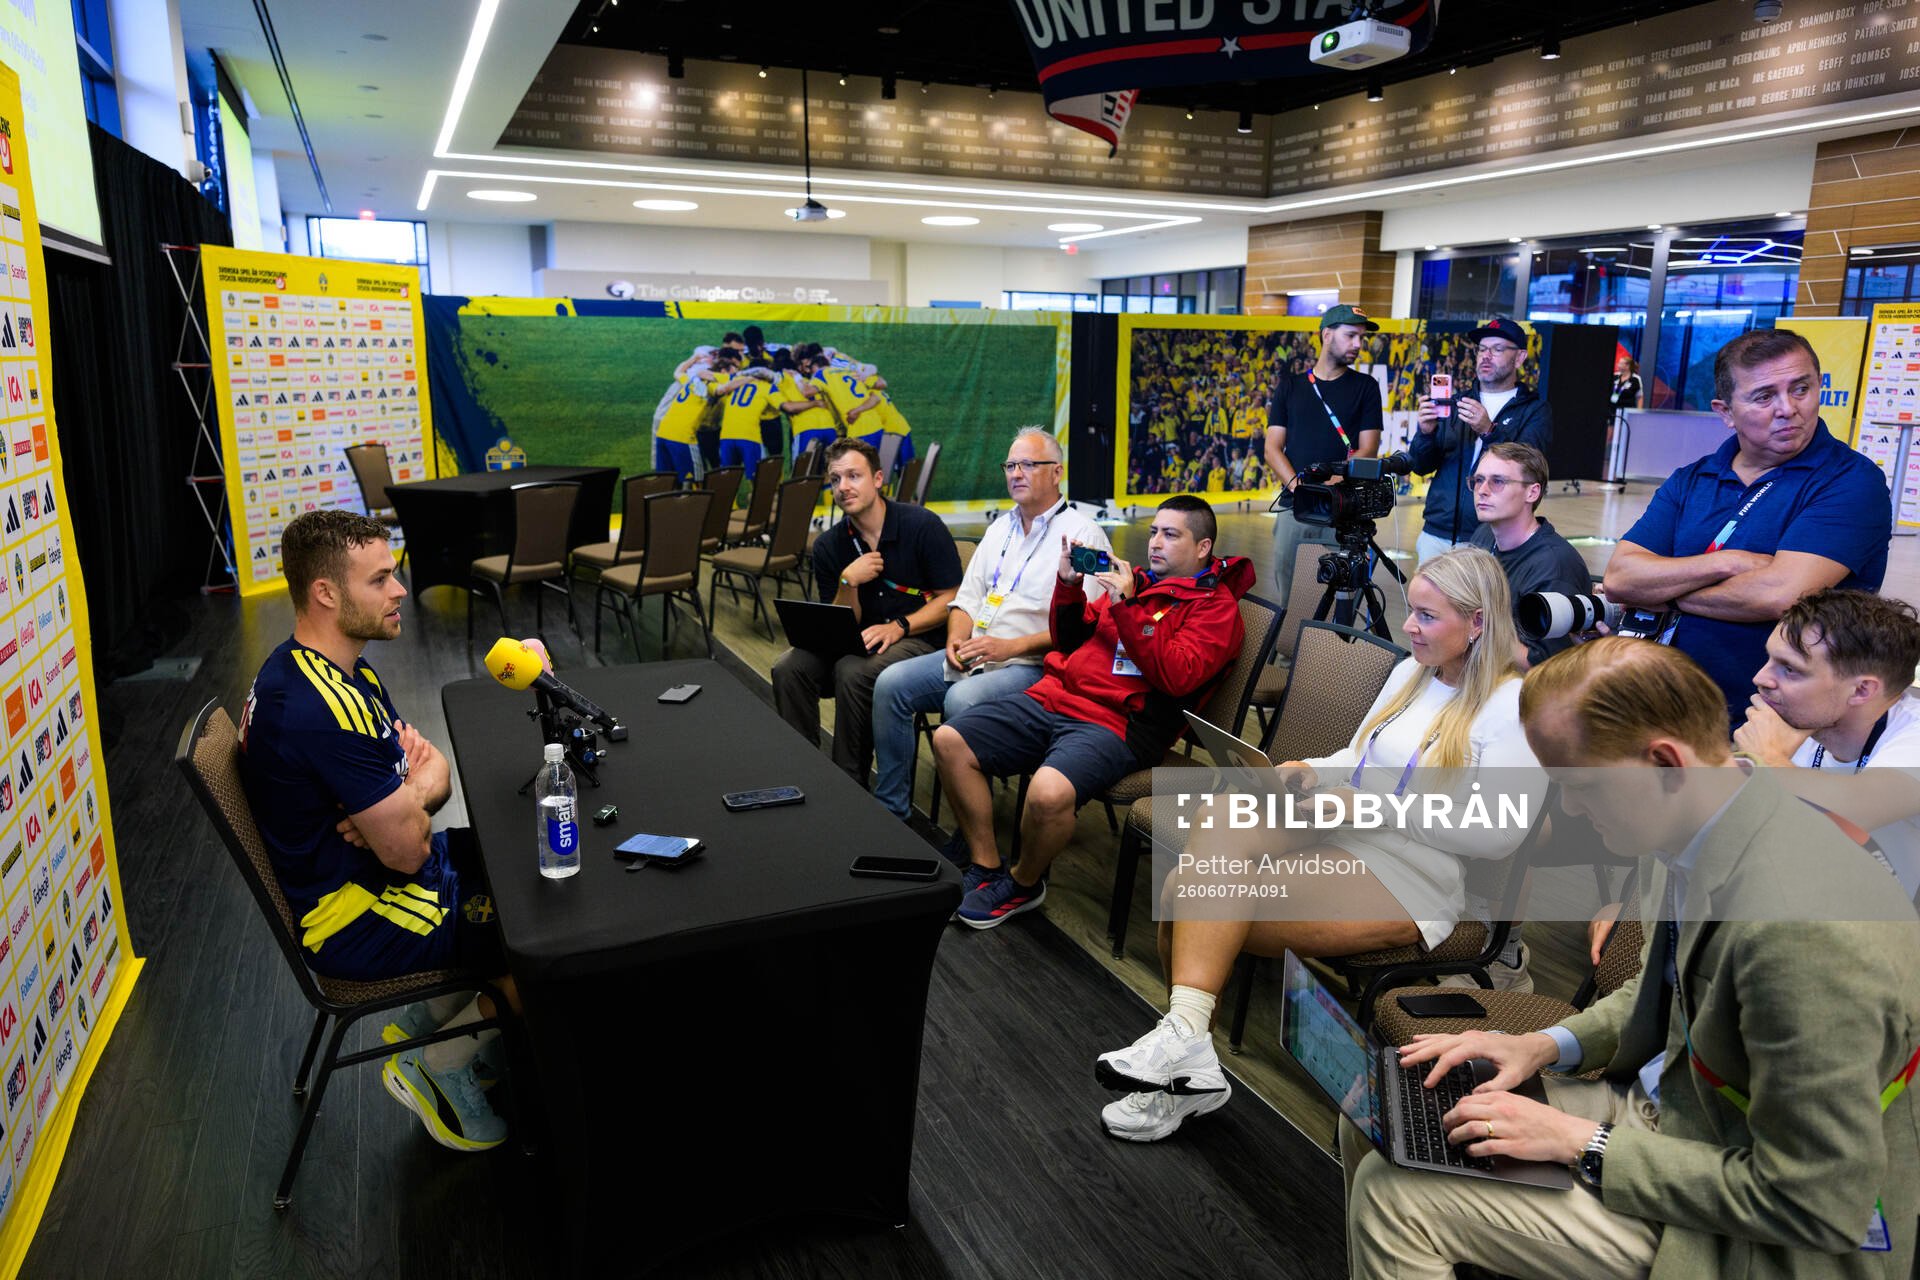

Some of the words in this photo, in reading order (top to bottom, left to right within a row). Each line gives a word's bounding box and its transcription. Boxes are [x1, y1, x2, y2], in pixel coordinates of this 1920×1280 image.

[1800, 11, 1834, 28] SHANNON
[1836, 6, 1856, 20] BOXX
[1863, 0, 1884, 14] HOPE
[1740, 28, 1759, 42] CLINT
[1761, 20, 1792, 36] DEMPSEY
[1854, 24, 1888, 40] PATRICK
[1890, 16, 1918, 32] SMITH
[1787, 41, 1806, 54] APRIL
[1808, 32, 1848, 50] HEINRICHS
[1608, 60, 1625, 71] KEVIN
[1651, 50, 1670, 62] STEVE
[1733, 53, 1752, 67] PETER
[1753, 46, 1781, 61] COLLINS
[1818, 56, 1844, 71] GEOFF
[1851, 48, 1891, 64] COOMBES
[1664, 67, 1682, 80] FRANZ
[1684, 58, 1726, 76] BECKENBAUER
[1752, 72, 1766, 84] JOE
[1616, 79, 1630, 90] ALEX
[1705, 81, 1716, 93] JOE
[1720, 77, 1740, 90] MACA
[1761, 90, 1790, 104] GEORGE
[1792, 84, 1816, 98] TINTLE
[1822, 80, 1841, 94] JACK
[1844, 73, 1886, 90] JOHNSTON
[1646, 92, 1666, 104] FRANK
[1707, 102, 1724, 114] JOHN
[1736, 96, 1756, 108] WOOD
[1664, 106, 1703, 121] ARMSTRONG
[638, 283, 668, 298] The
[670, 284, 739, 302] Gallagher
[742, 286, 774, 300] Club
[8, 375, 22, 403] ICA
[730, 383, 756, 406] 10
[843, 376, 864, 398] 2
[1738, 500, 1753, 516] FIFA
[1751, 481, 1773, 502] WORLD
[46, 662, 60, 686] Scandic
[28, 677, 42, 709] ICA
[26, 813, 41, 848] ICA
[33, 876, 50, 908] Fabege
[12, 905, 30, 940] Scandic
[20, 964, 38, 1001] Folksam
[0, 1002, 16, 1046] ICA
[56, 1039, 72, 1076] Fabege
